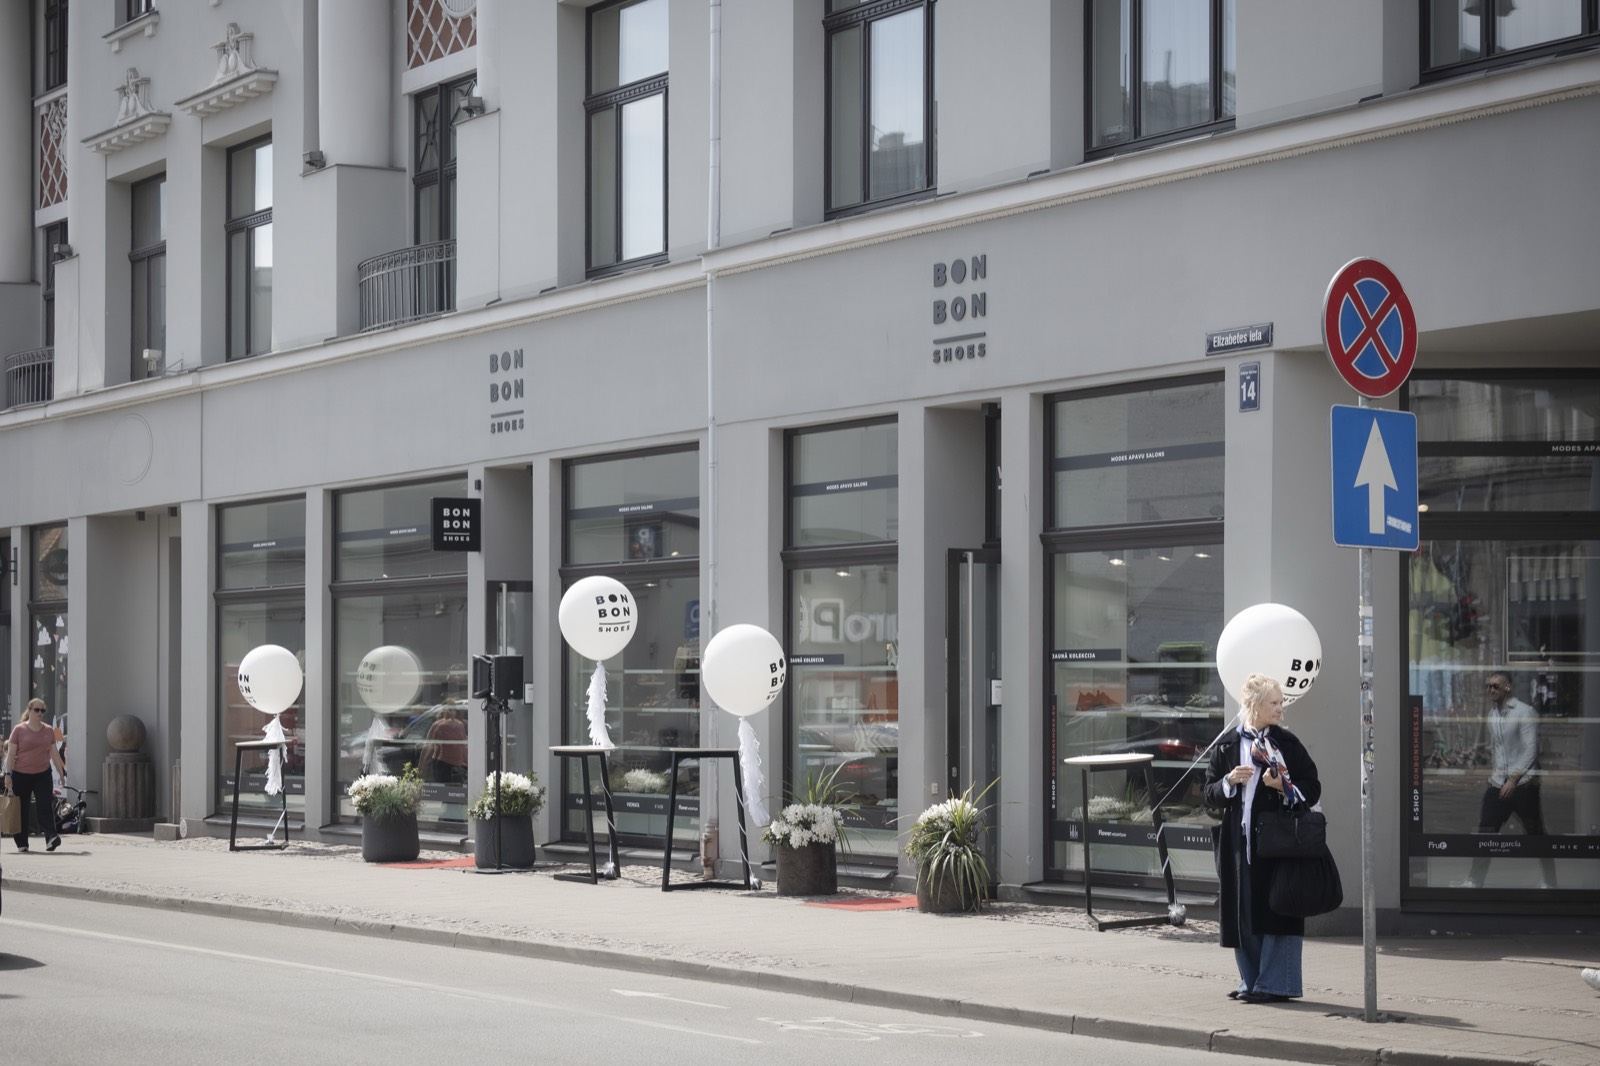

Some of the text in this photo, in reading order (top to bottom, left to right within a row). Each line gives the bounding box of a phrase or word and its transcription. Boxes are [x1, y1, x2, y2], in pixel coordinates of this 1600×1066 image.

[933, 254, 987, 288] BON
[932, 292, 986, 325] BON
[1213, 330, 1262, 348] Elizabetes iela
[489, 348, 524, 374] BON
[932, 343, 986, 364] SHOES
[489, 378, 524, 403] BON
[1240, 381, 1256, 402] 14
[490, 418, 524, 434] SHOES
[1128, 453, 1145, 461] APAVU
[1145, 451, 1165, 459] SALONS
[443, 507, 470, 517] BON
[443, 519, 470, 529] BON
[595, 593, 629, 605] BON
[597, 606, 631, 619] BON
[598, 624, 631, 633] SHOES
[1478, 840, 1521, 849] pedro garcía
